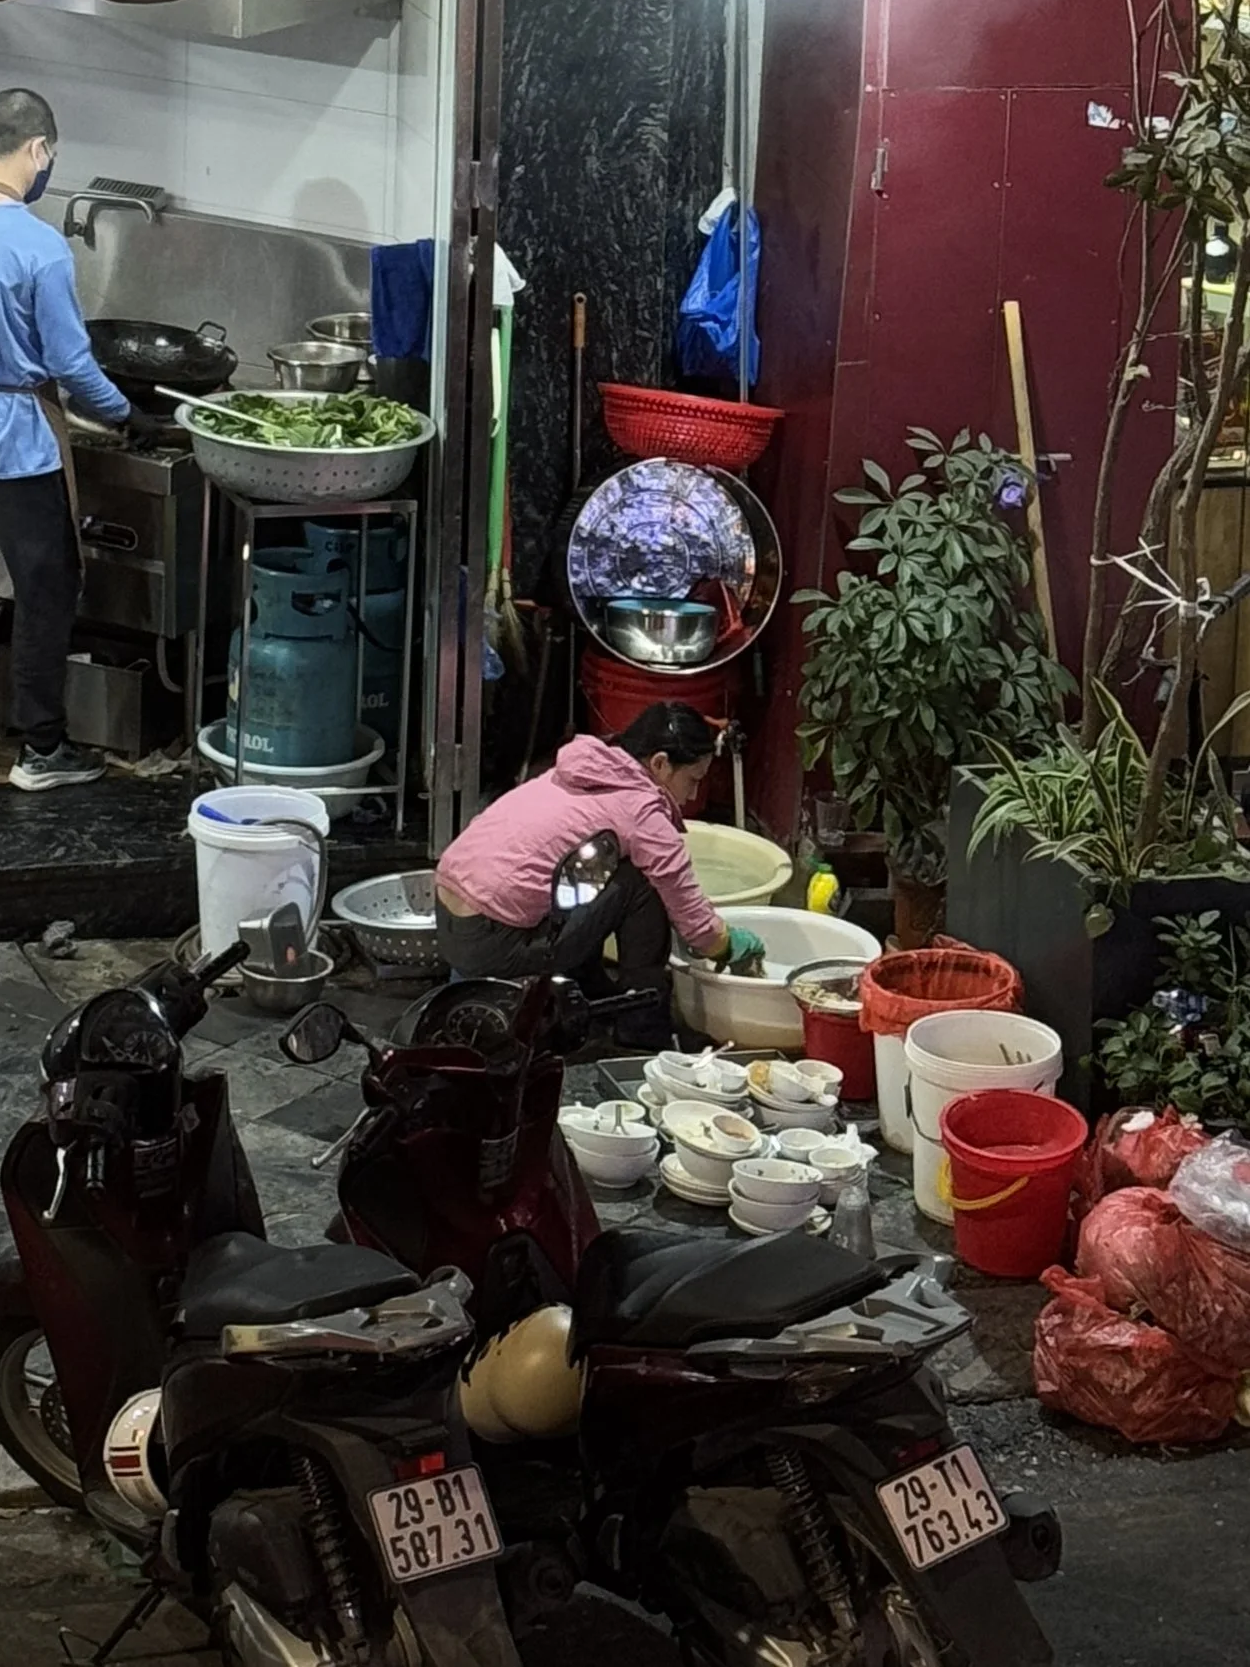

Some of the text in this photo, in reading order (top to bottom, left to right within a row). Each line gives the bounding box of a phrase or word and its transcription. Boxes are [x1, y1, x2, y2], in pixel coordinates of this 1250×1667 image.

[387, 1474, 471, 1530] 29-B1
[894, 1454, 971, 1520] 29-T1
[390, 1512, 493, 1573] 587.31
[904, 1489, 998, 1564] 763.43
